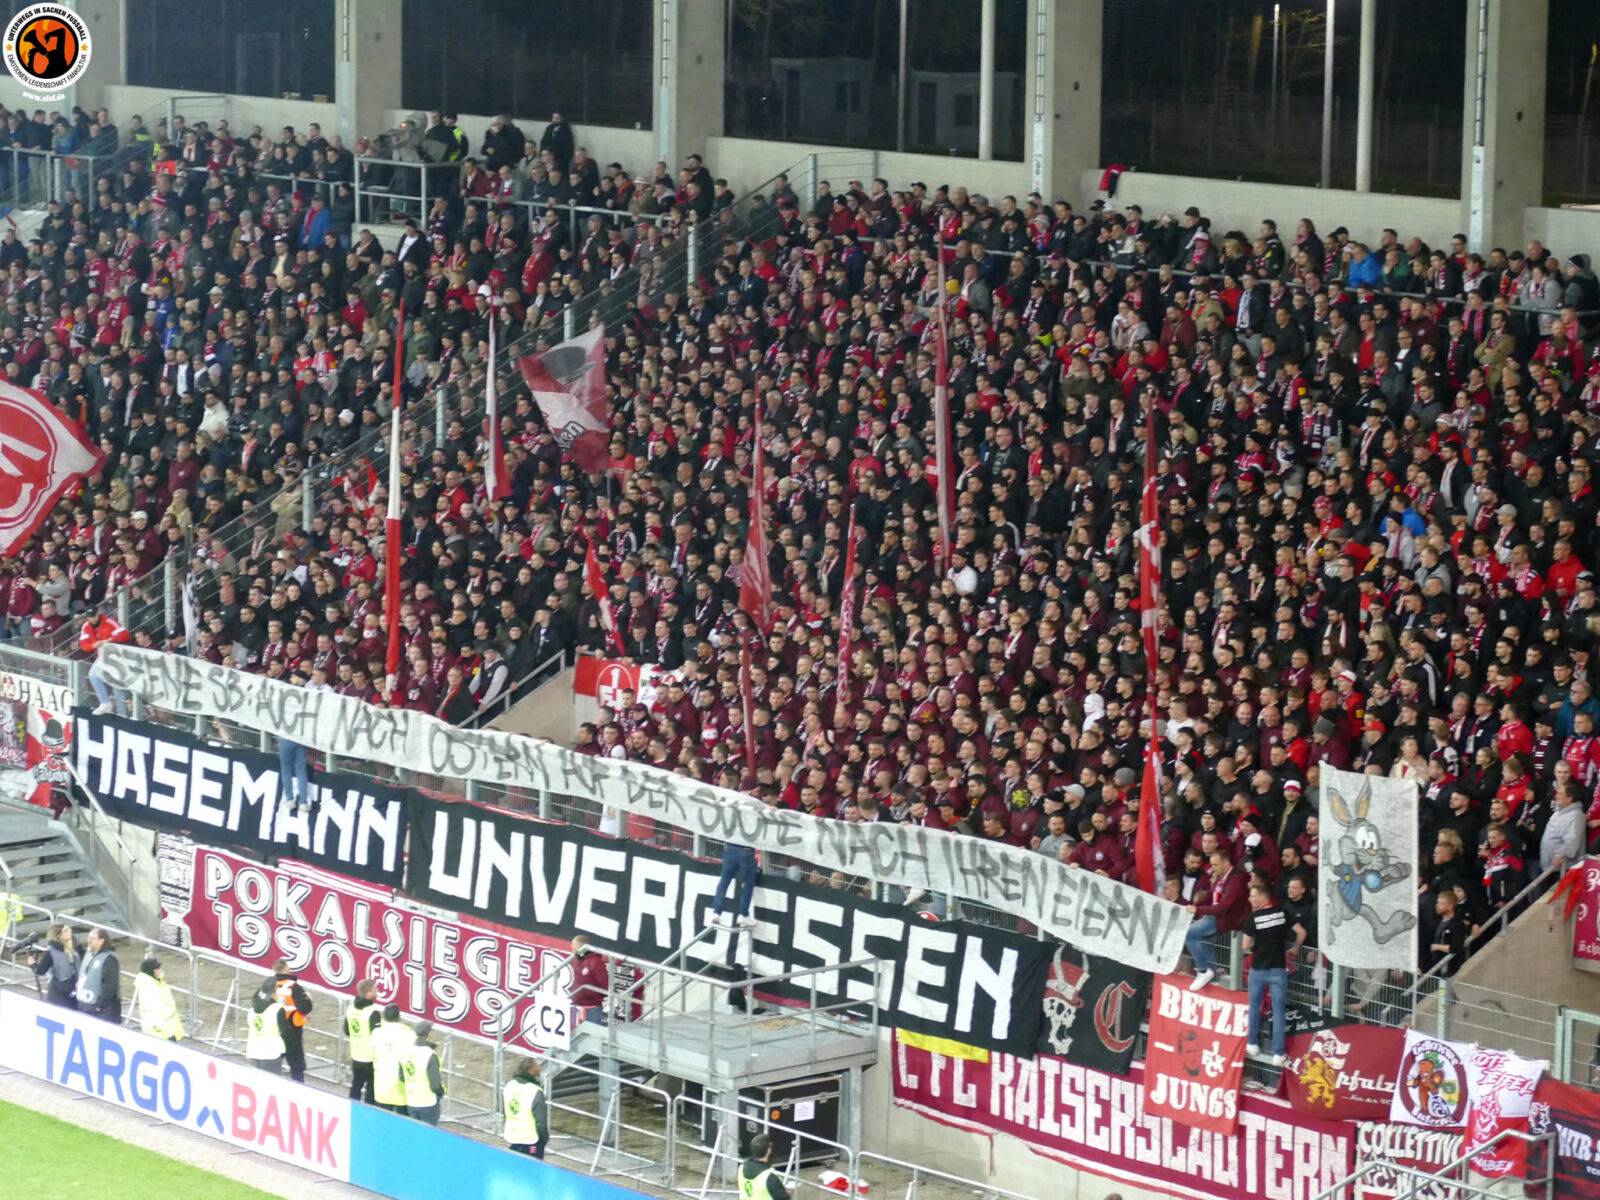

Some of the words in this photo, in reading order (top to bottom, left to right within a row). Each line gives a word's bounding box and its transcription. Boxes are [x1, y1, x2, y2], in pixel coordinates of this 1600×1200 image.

[102, 643, 203, 710] SZENE
[256, 678, 323, 746] AUCH
[330, 697, 409, 754] NACH
[688, 787, 802, 846] SUCHE
[815, 817, 931, 888] NACH
[940, 836, 1048, 919] IHREN
[1051, 864, 1182, 964] EIERN!
[76, 718, 402, 872] HASEMANN
[428, 810, 1019, 1040] UNVERGESSEN
[204, 853, 575, 998] POKALSIEGER
[211, 900, 356, 988] 1990
[540, 1005, 565, 1037] C2
[1158, 982, 1249, 1037] BETZE
[36, 1014, 192, 1122] TARGO
[231, 1081, 340, 1169] BANK
[990, 1051, 1348, 1200] KAISERSLAUTERN
[1150, 1072, 1237, 1120] JUNGS
